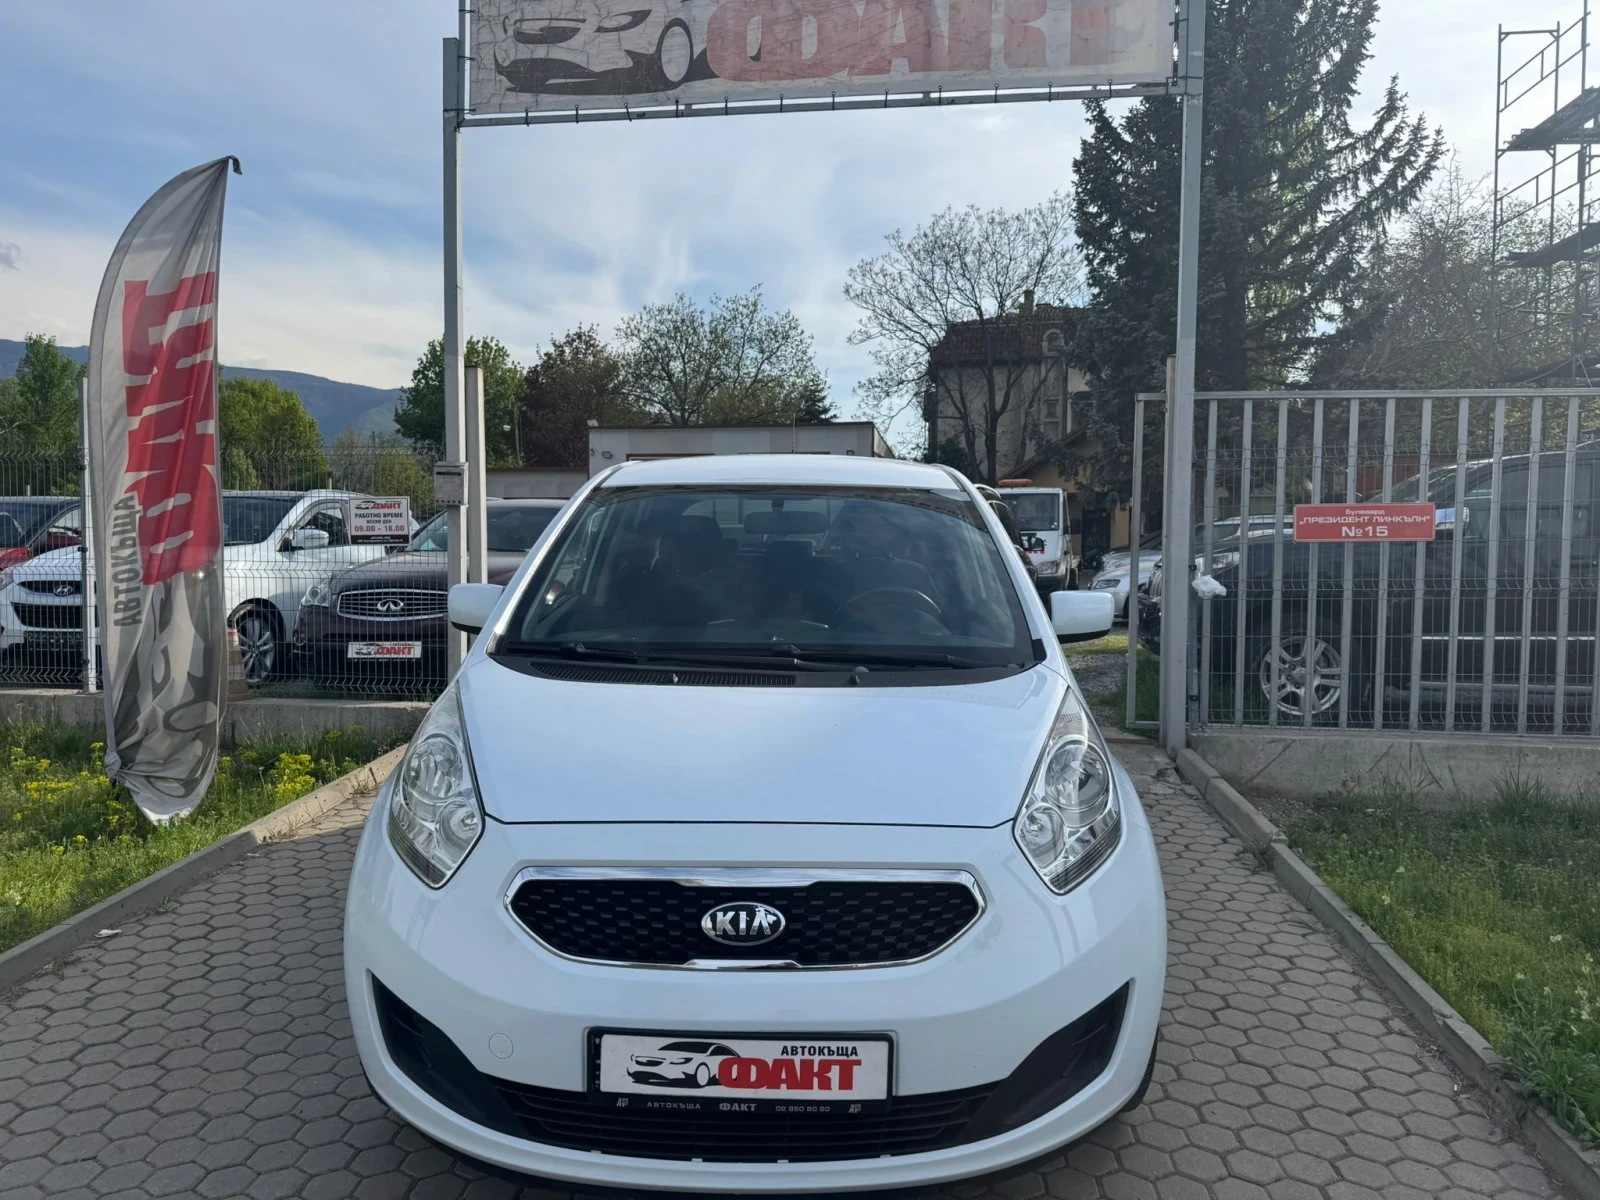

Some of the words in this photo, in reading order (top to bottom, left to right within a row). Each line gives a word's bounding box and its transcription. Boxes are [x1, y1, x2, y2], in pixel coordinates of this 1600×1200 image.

[111, 494, 143, 628] АВТОКЪЩА
[715, 909, 772, 936] KIA
[780, 1045, 859, 1058] АВТОКЪЩА
[717, 1057, 862, 1091] ФАКТ
[719, 1102, 757, 1111] ФАКТ
